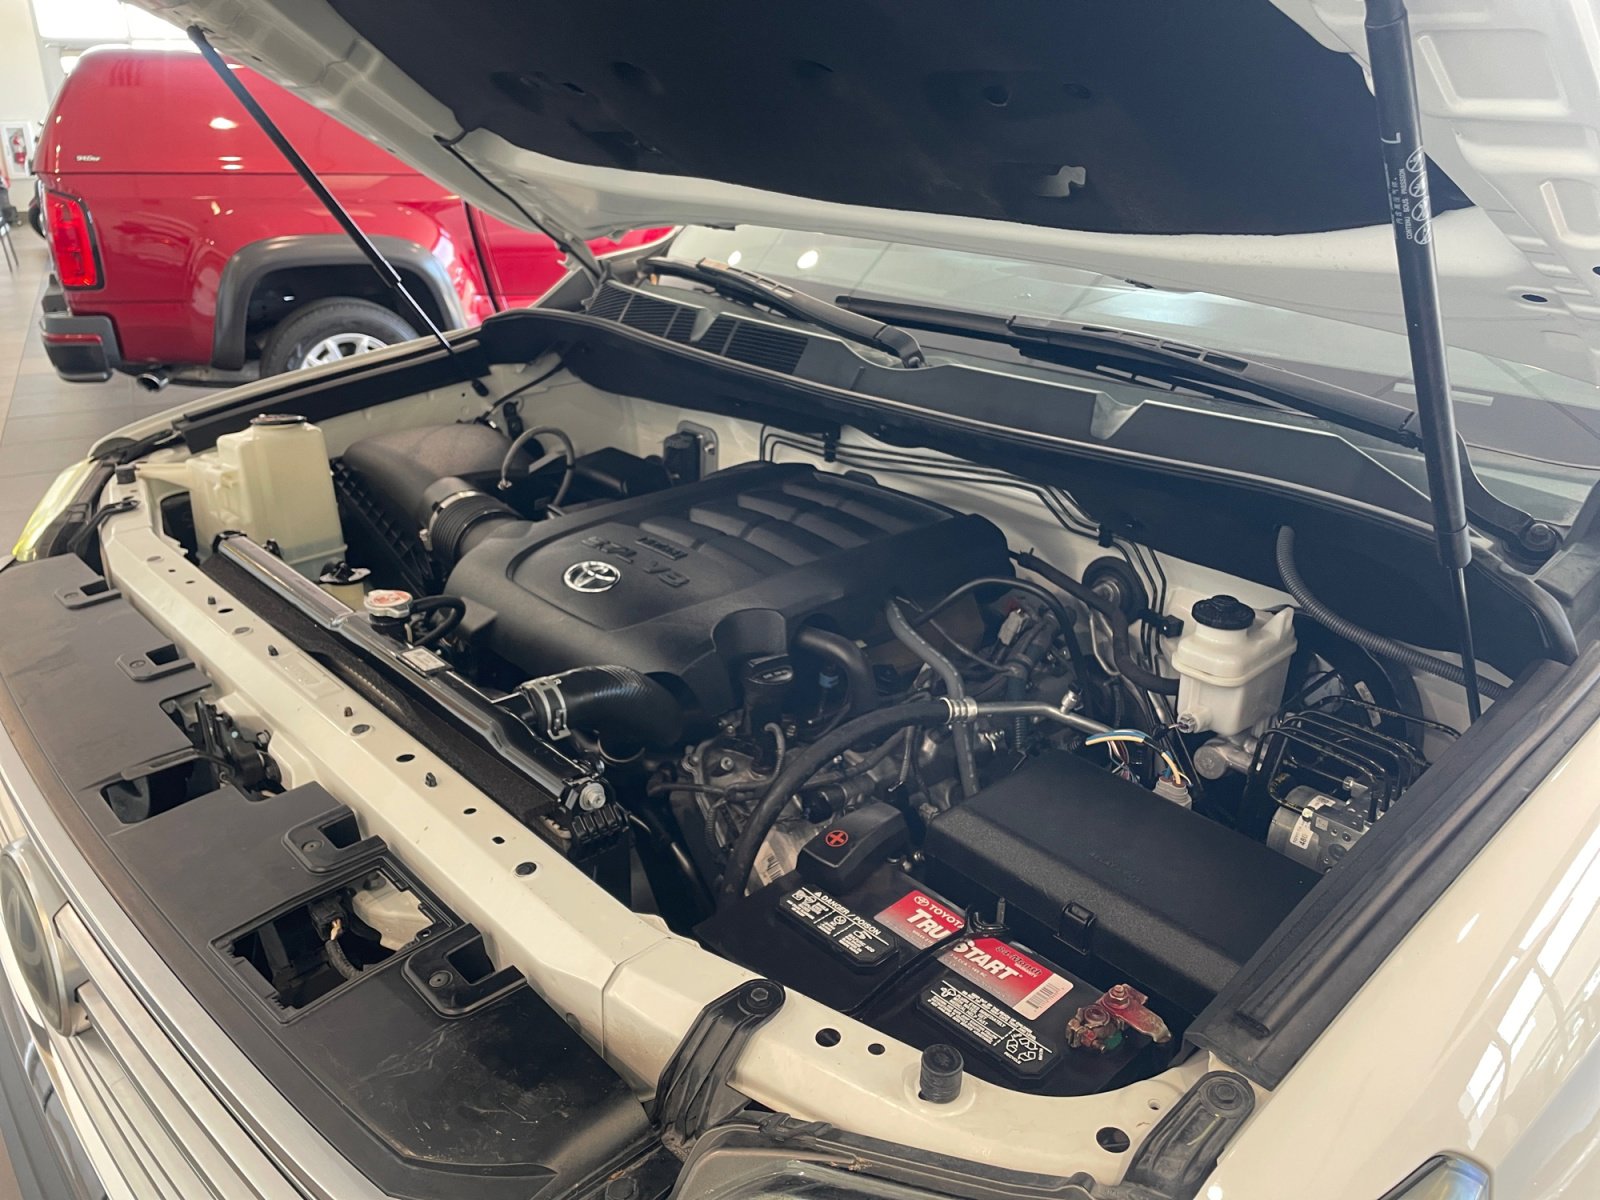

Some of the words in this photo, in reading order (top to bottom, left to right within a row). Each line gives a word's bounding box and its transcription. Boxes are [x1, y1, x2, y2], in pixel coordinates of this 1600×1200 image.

[820, 895, 850, 915] DANGER
[853, 916, 881, 936] POISON
[907, 908, 952, 939] TRU
[929, 903, 965, 929] TOYOTA
